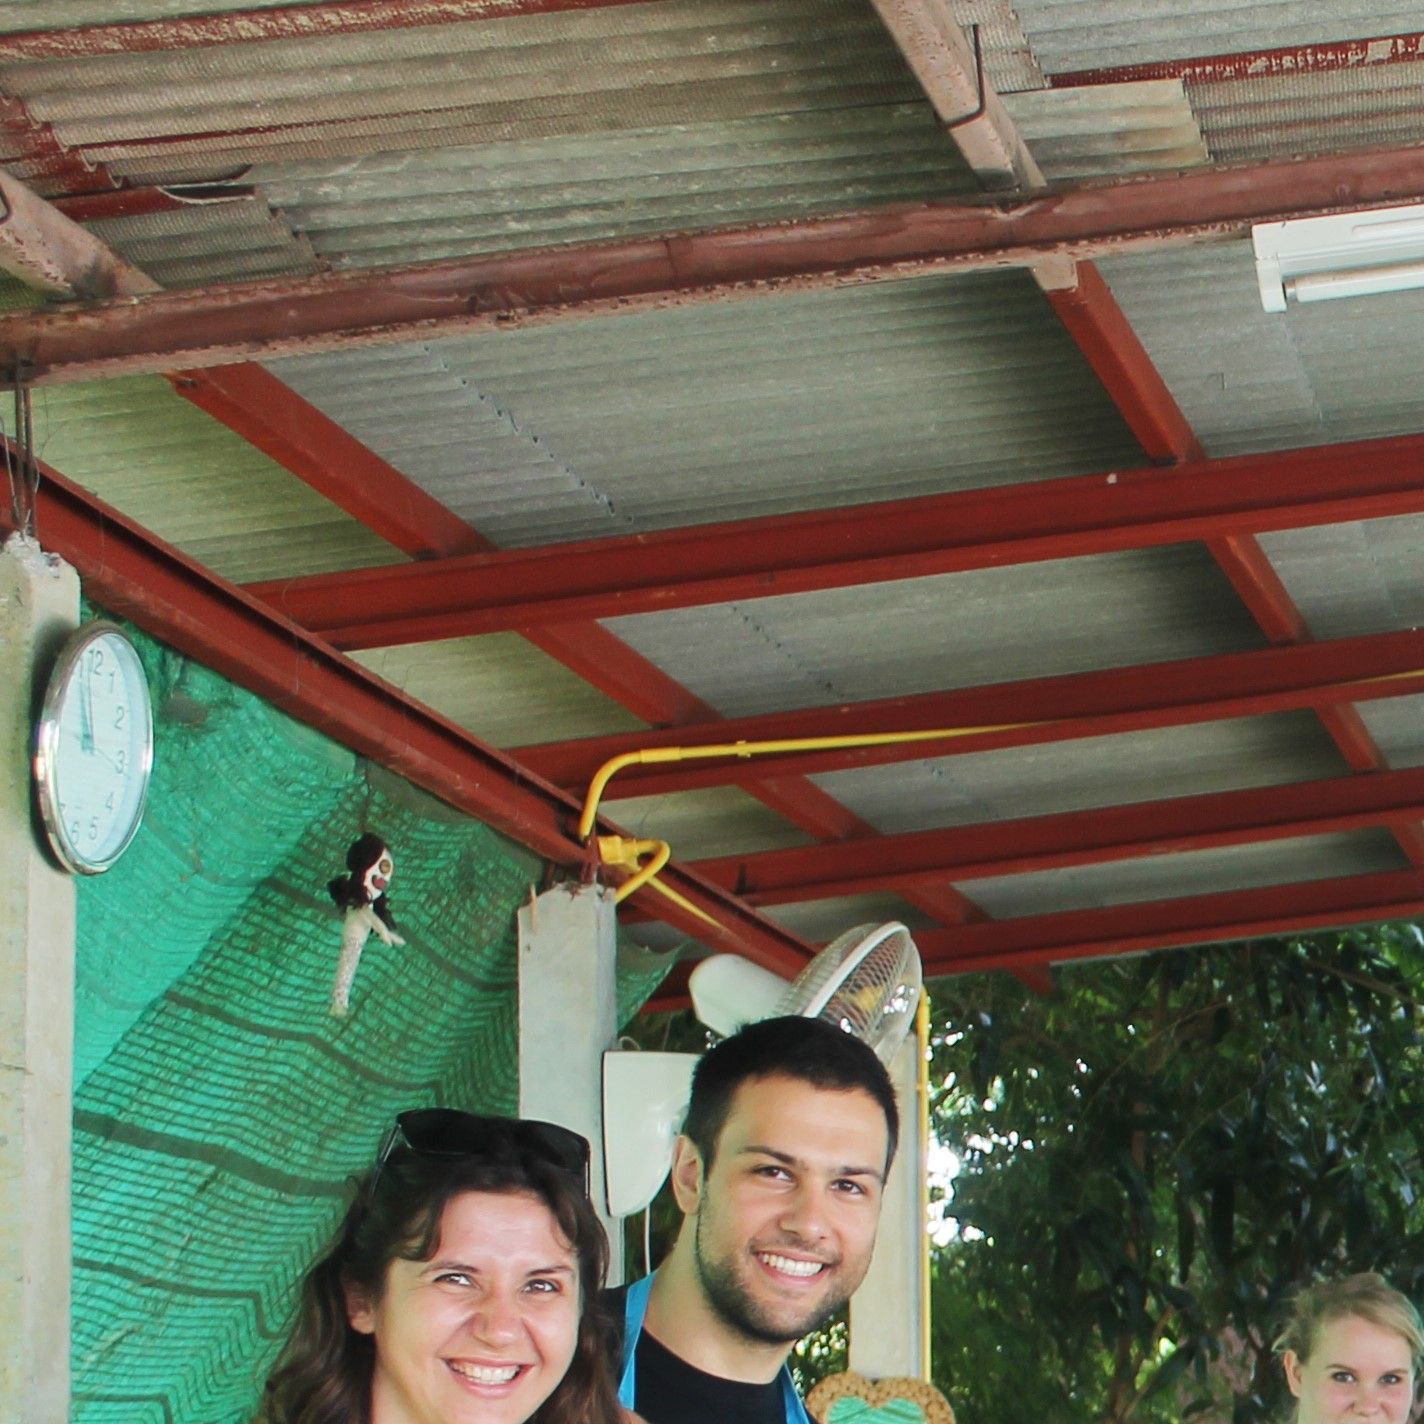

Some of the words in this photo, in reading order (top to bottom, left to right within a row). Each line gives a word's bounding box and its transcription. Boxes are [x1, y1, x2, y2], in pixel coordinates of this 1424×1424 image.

[114, 705, 124, 730] 2
[115, 750, 126, 775] 3
[88, 815, 99, 841] 5
